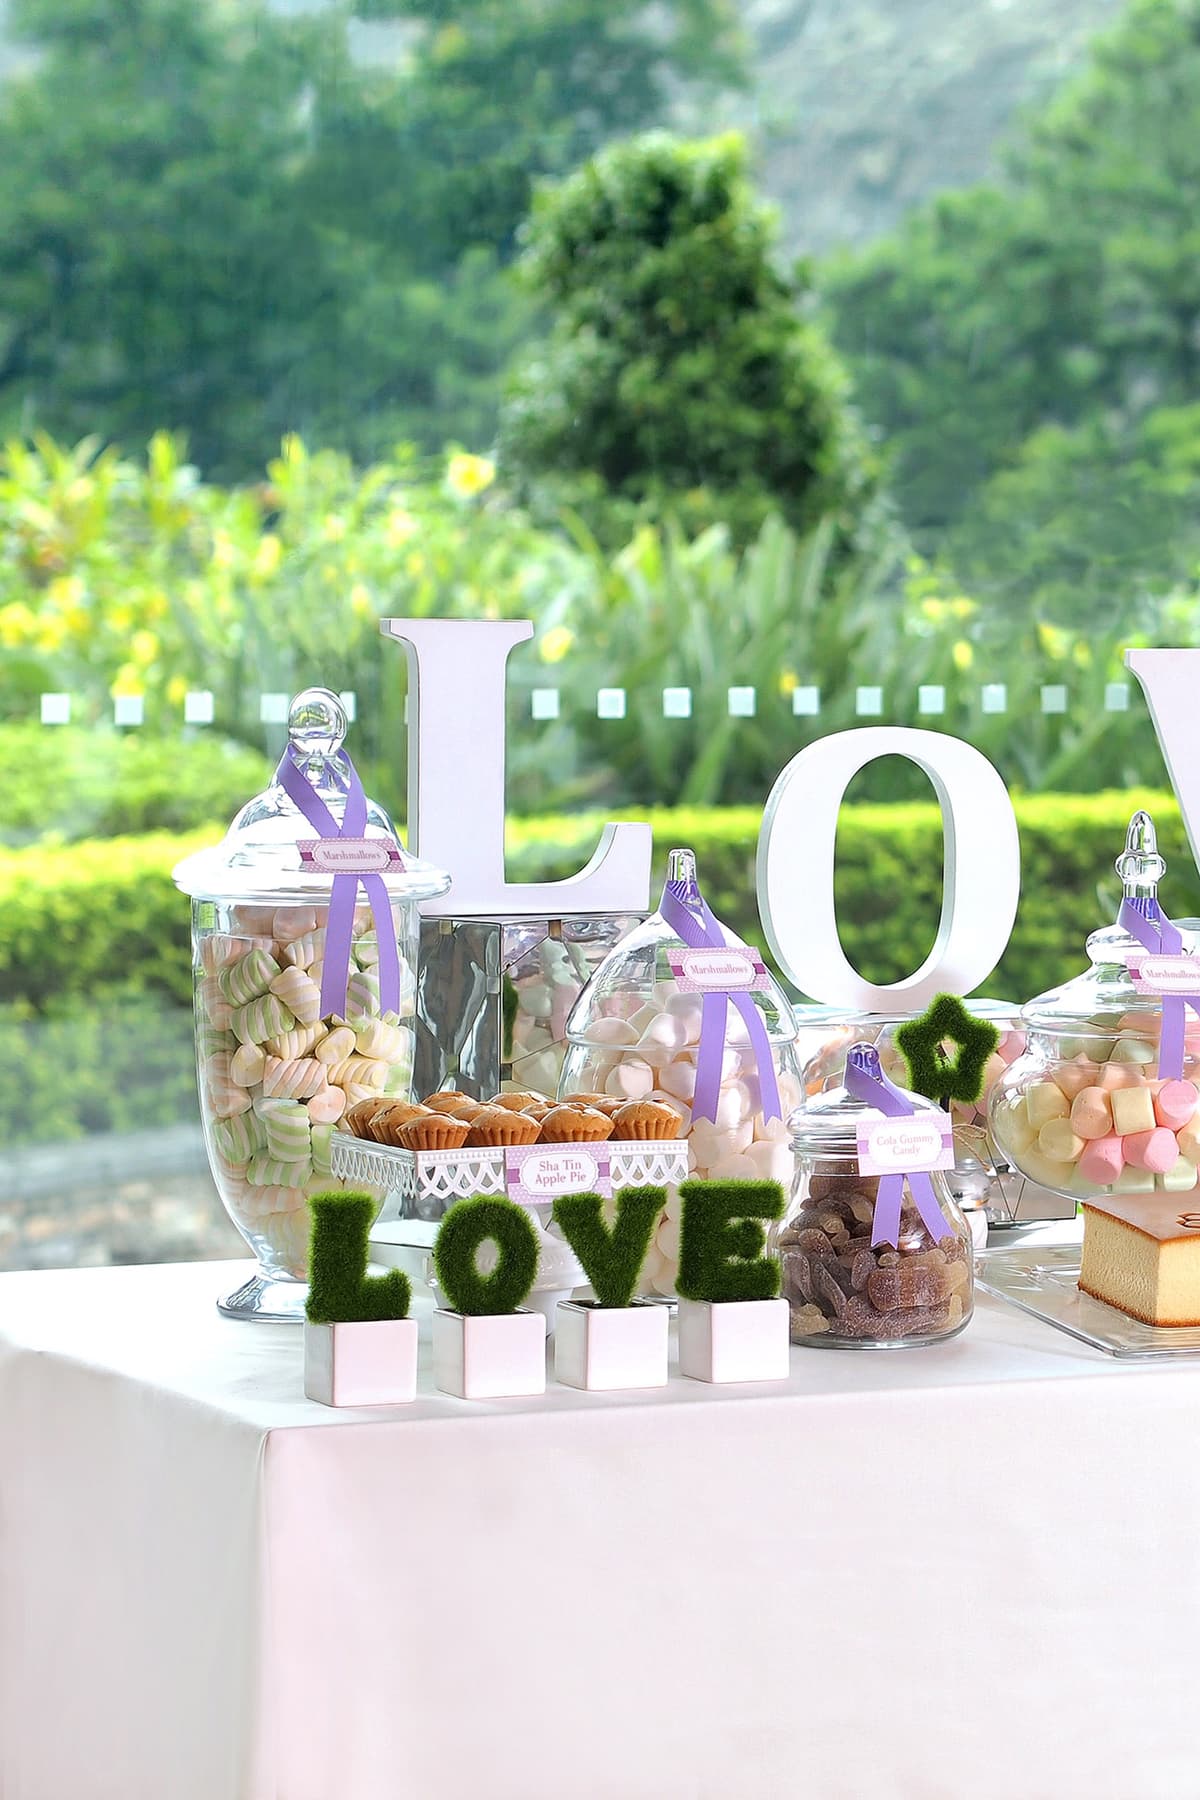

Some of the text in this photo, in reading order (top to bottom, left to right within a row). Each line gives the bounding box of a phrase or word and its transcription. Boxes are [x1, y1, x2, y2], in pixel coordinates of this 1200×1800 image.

[322, 849, 382, 861] Marshmallows
[689, 963, 749, 975] Marshmallows
[876, 1134, 934, 1146] Cola Gummy
[892, 1145, 921, 1157] Candy
[539, 1159, 582, 1172] Sha Tin
[535, 1171, 587, 1187] Apple Pie
